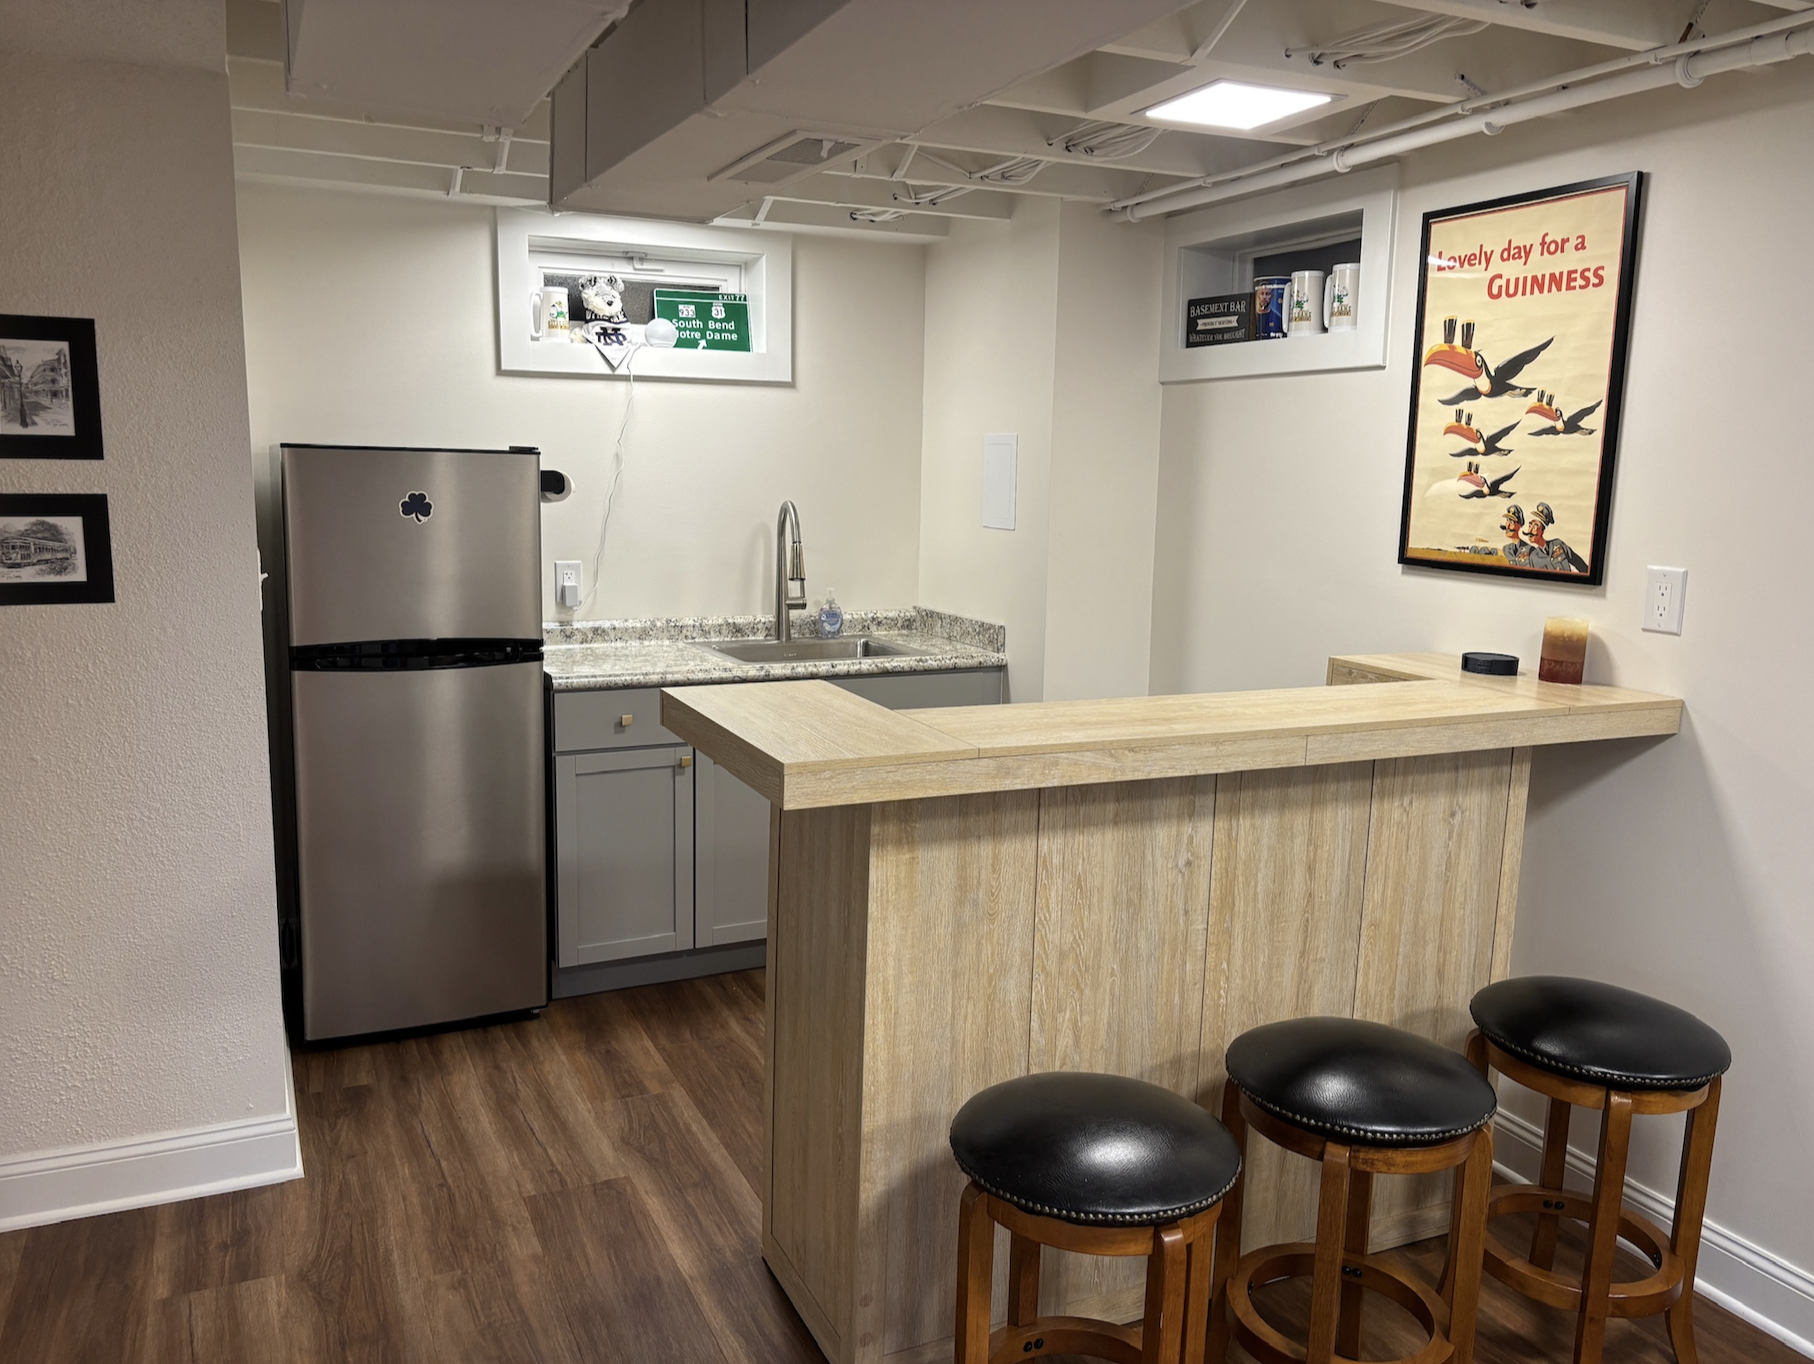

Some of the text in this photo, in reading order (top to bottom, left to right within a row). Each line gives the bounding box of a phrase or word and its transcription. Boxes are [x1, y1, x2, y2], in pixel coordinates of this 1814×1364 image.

[1436, 232, 1587, 272] Lovely day for a
[1487, 265, 1605, 300] GUINNESS
[719, 294, 734, 302] EXIT
[679, 308, 695, 317] 933
[714, 308, 723, 317] 31
[1190, 300, 1246, 317] BASEMENT BAR
[672, 319, 735, 330] South Bend
[676, 331, 738, 341] otre Dame
